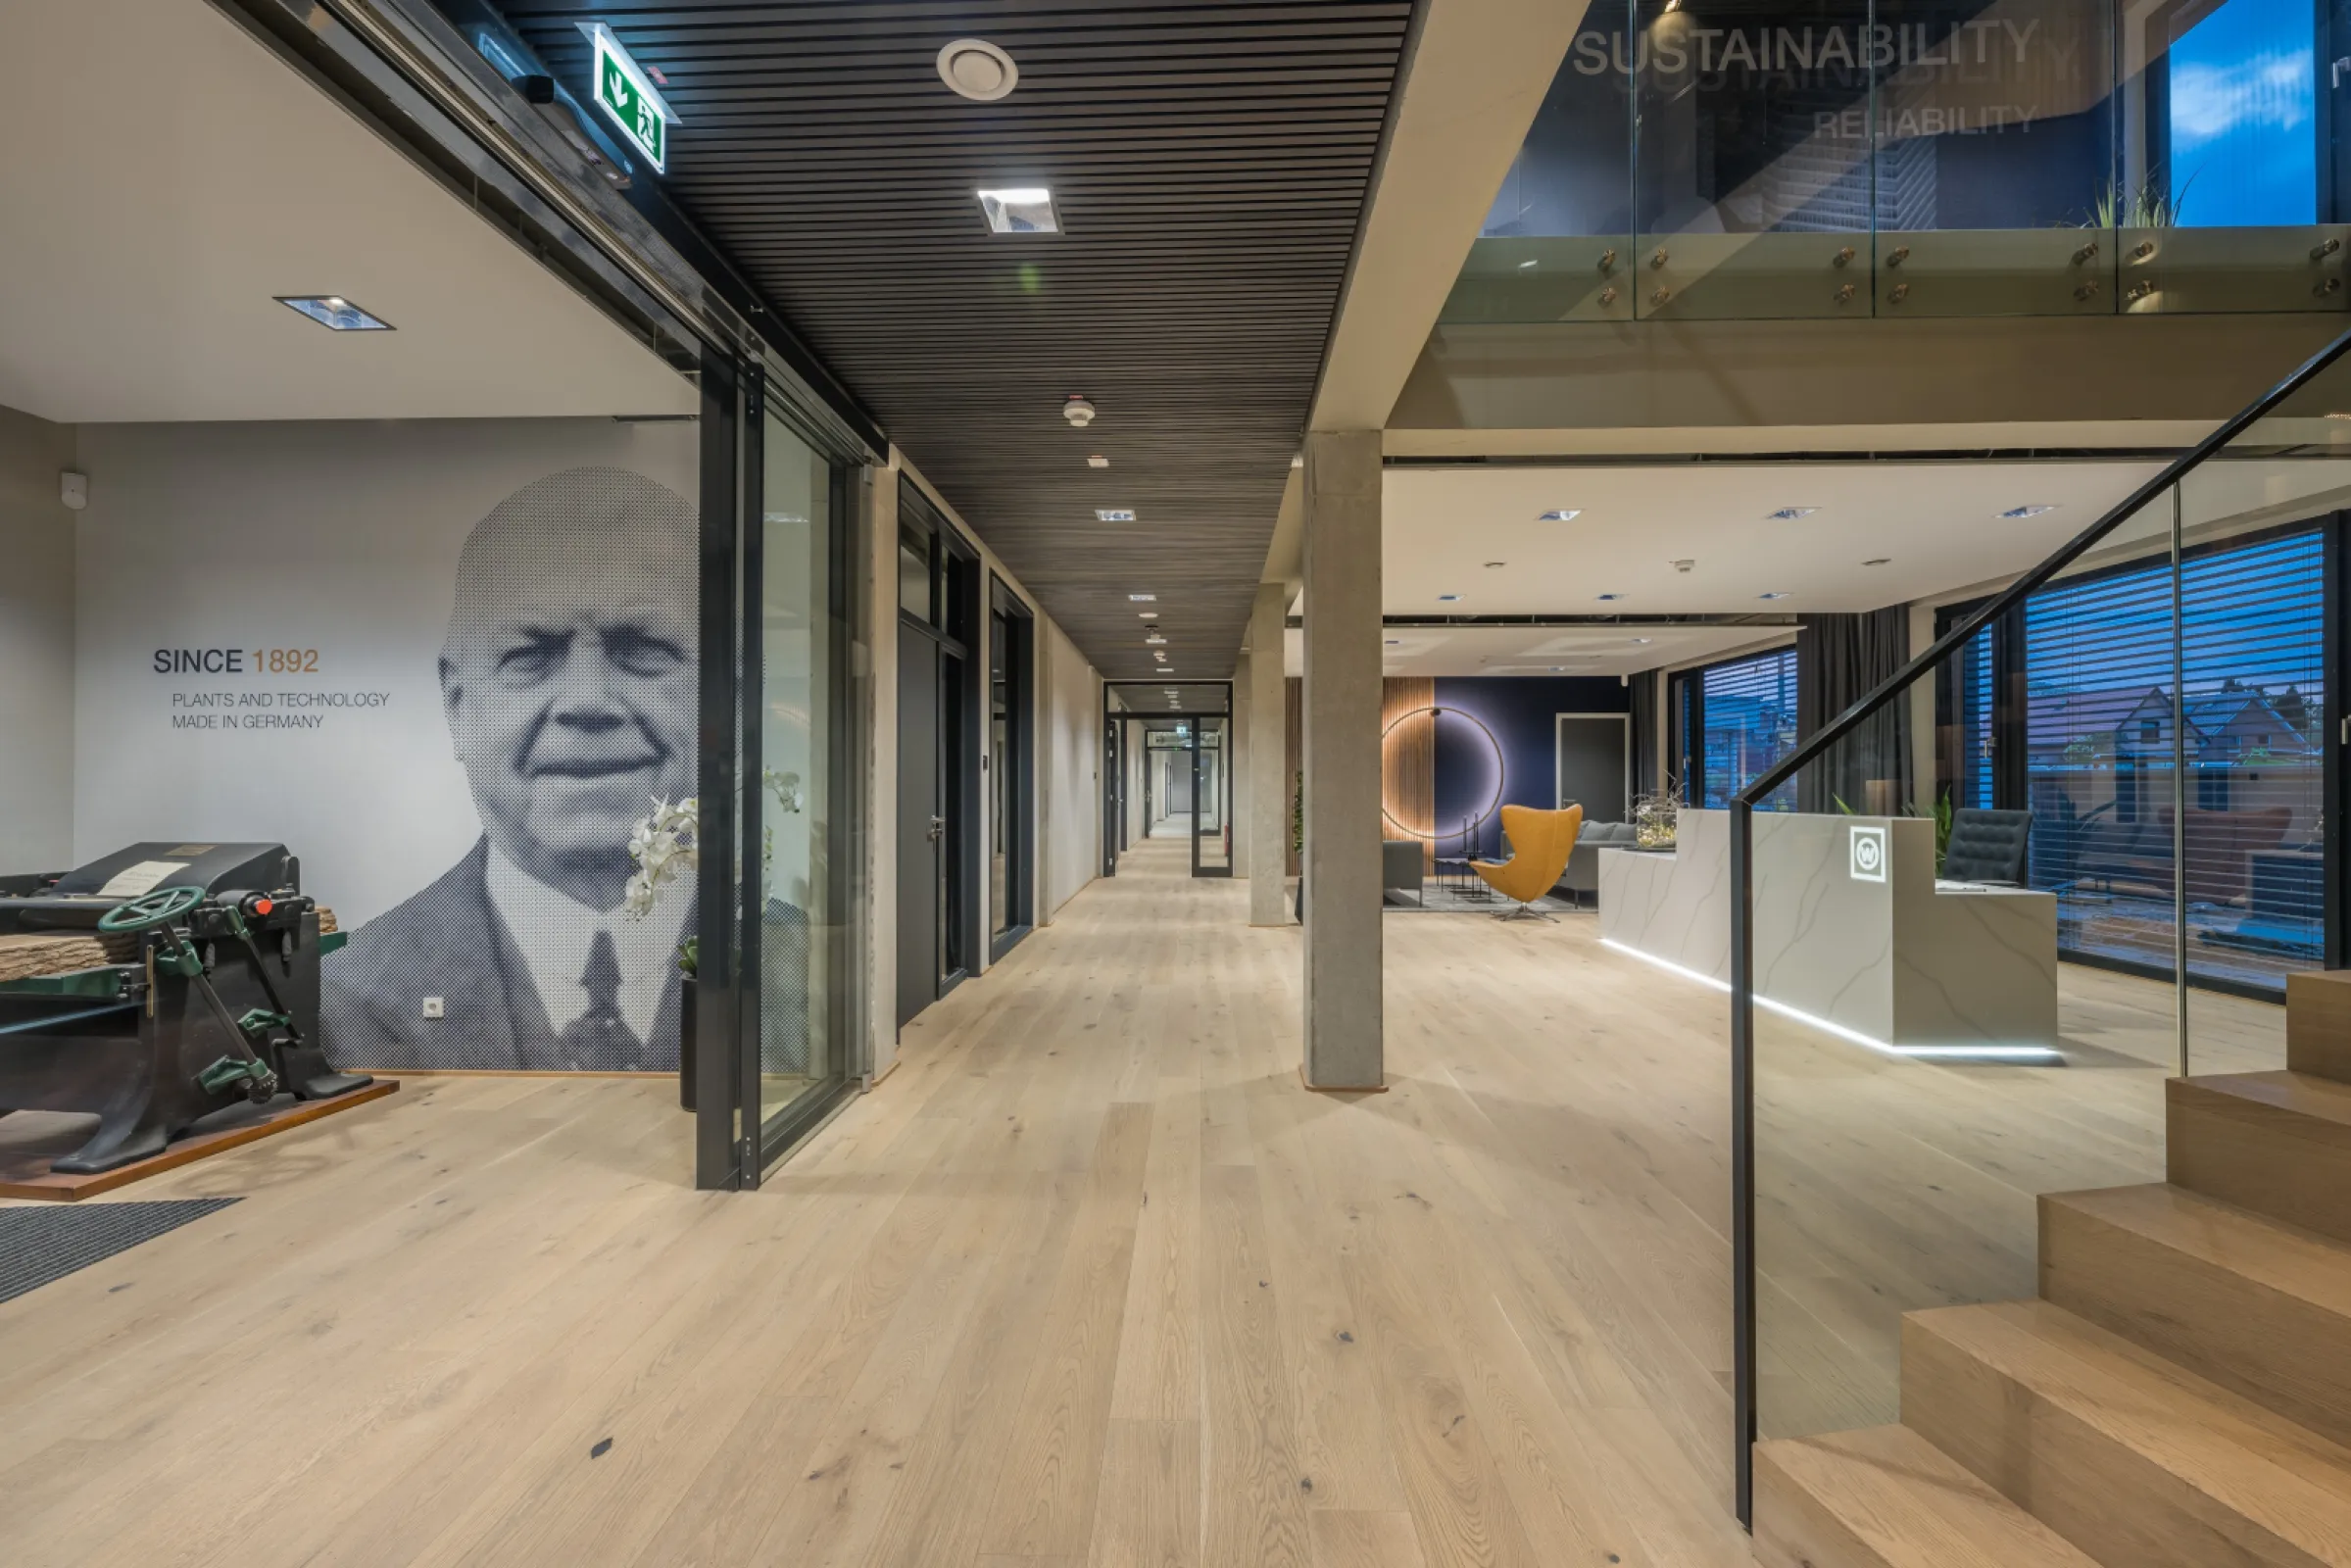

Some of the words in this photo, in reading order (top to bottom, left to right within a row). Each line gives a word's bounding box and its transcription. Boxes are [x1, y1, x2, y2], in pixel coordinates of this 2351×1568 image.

[1573, 18, 2040, 75] SUSTAINABILITY
[1814, 104, 2038, 139] RELIABILITY
[154, 650, 243, 673] SINCE
[252, 650, 319, 673] 1892
[172, 693, 234, 708] PLANTS
[238, 693, 272, 708] AND
[277, 693, 390, 708] TECHNOLOGY
[172, 714, 218, 729] MADE
[222, 714, 238, 729] IN
[242, 714, 324, 729] GERMANY
